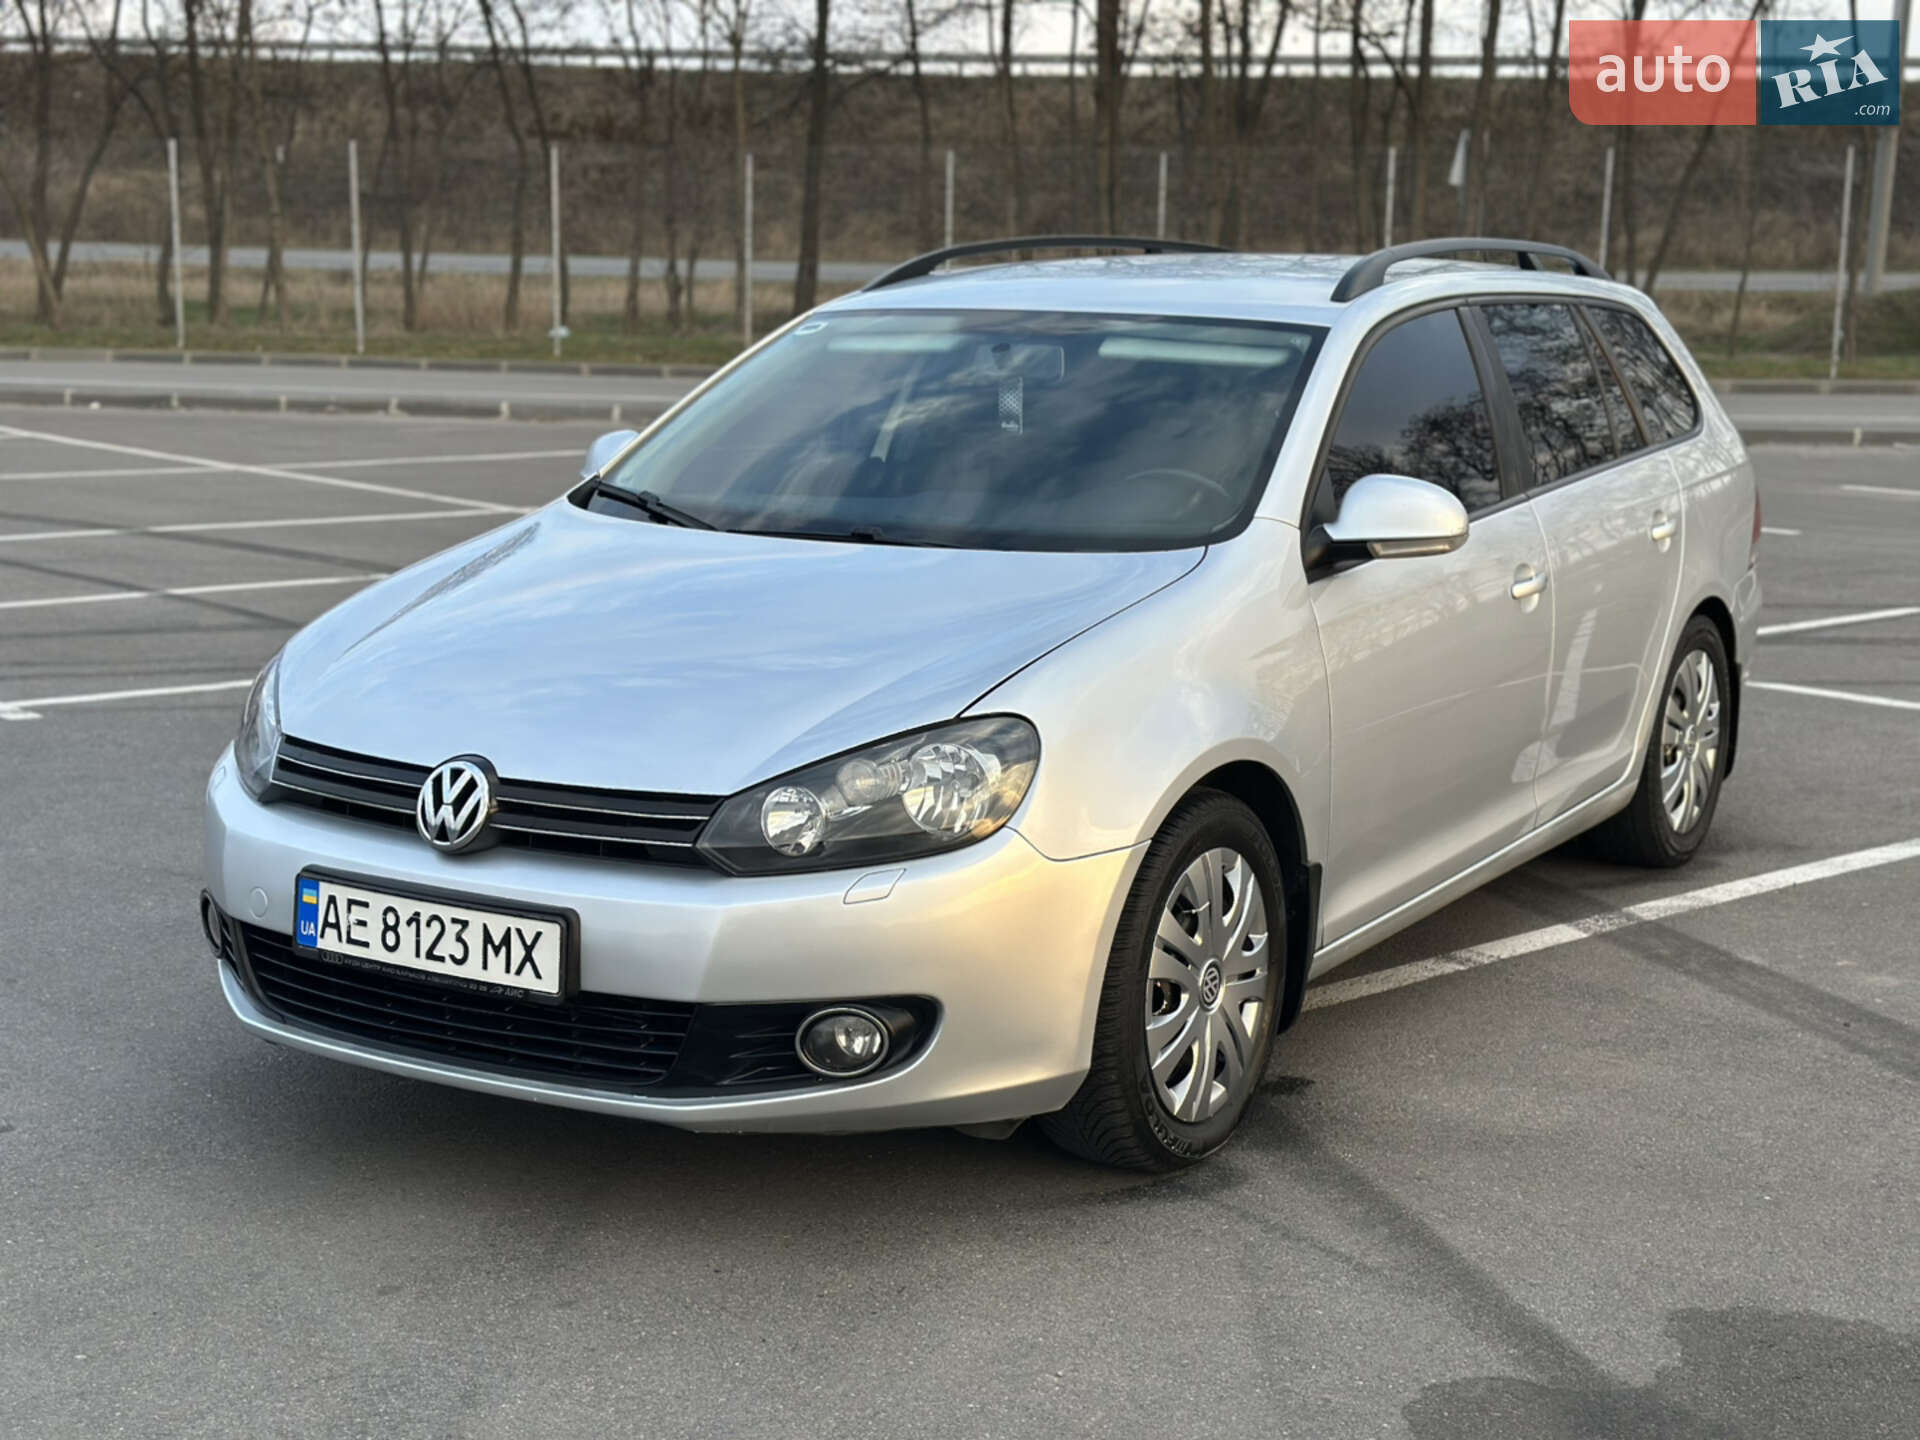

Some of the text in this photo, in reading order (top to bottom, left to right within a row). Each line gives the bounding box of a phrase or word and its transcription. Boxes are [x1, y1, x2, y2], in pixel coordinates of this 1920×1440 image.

[300, 920, 316, 937] UA
[319, 894, 370, 949] AE
[381, 905, 470, 966] 8123
[482, 922, 543, 980] MX
